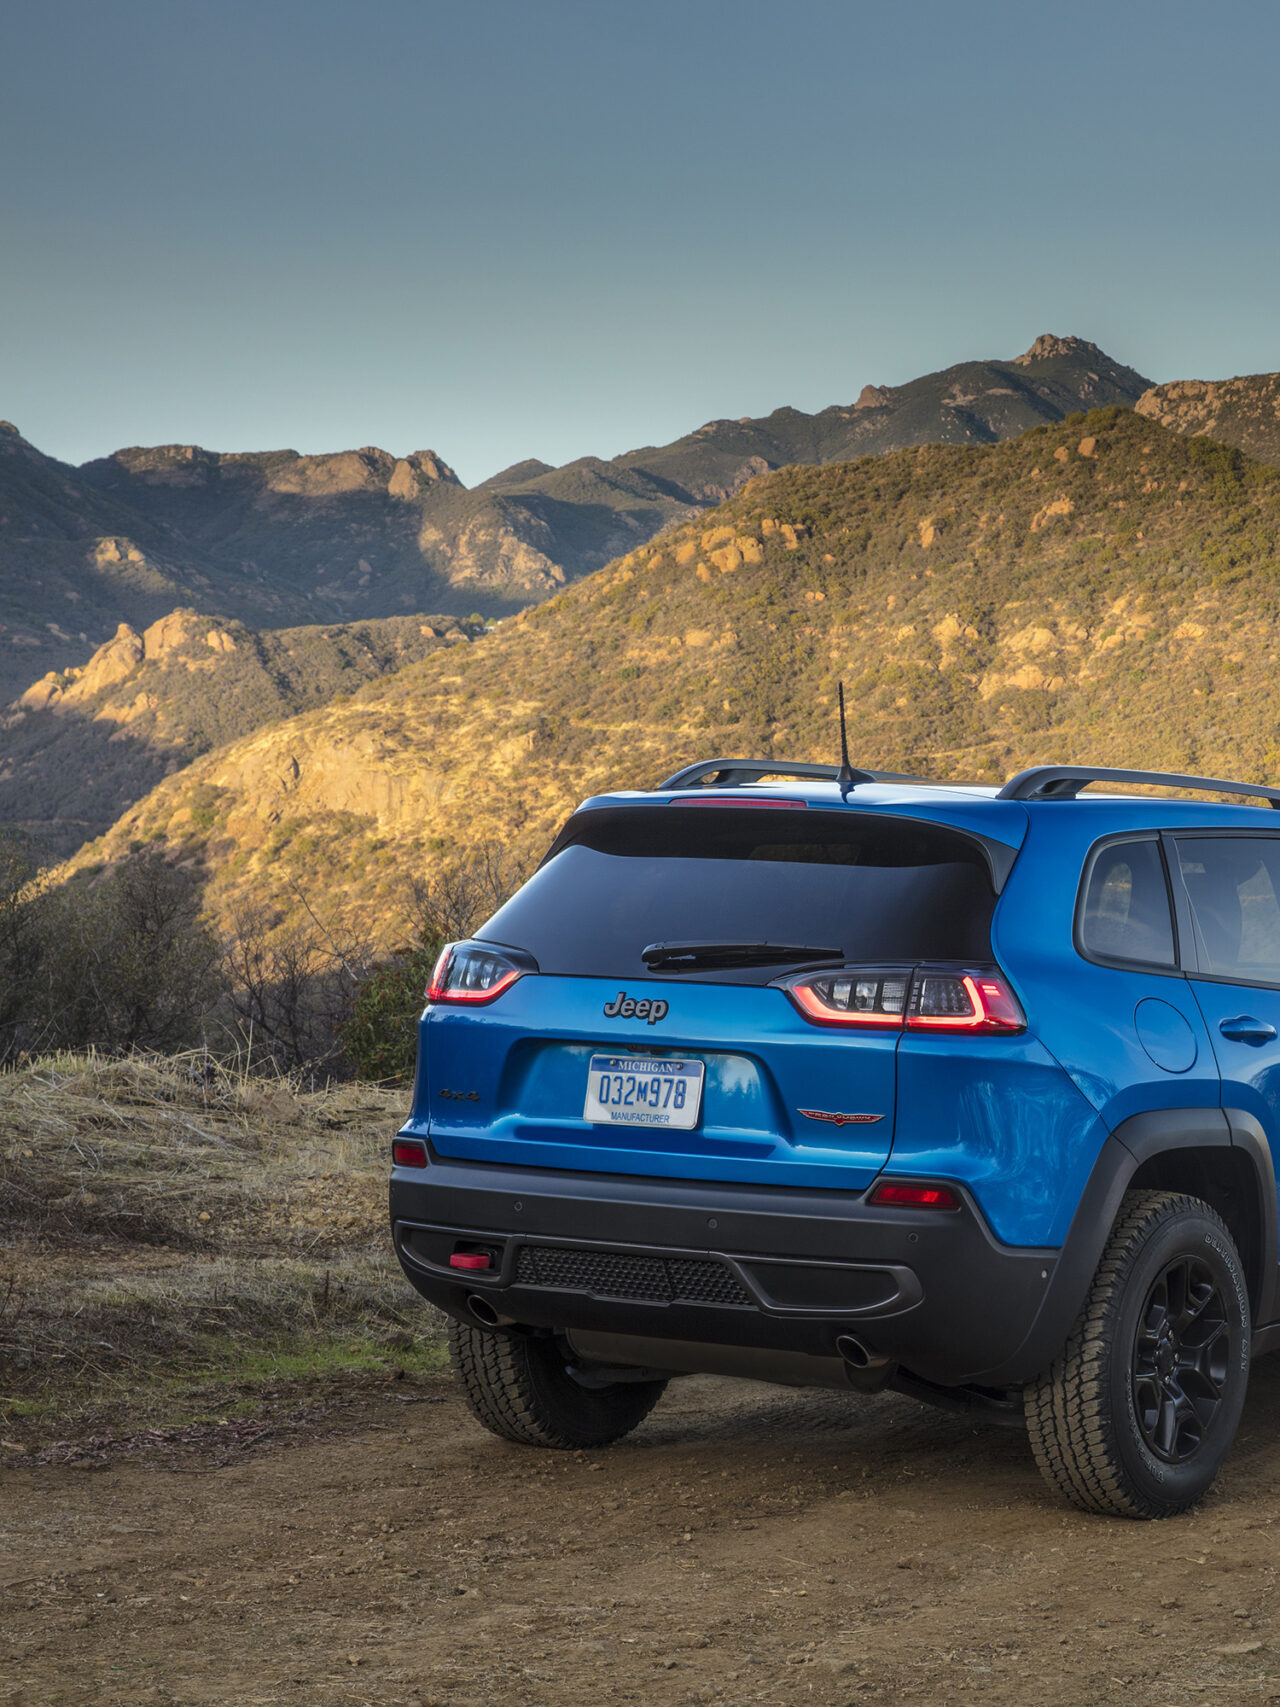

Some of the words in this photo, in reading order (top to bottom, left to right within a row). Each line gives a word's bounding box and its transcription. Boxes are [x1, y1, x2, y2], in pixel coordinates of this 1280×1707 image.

[604, 992, 669, 1025] Jeep
[618, 1060, 674, 1073] MICHIGAN
[599, 1074, 688, 1109] 032M978
[611, 1111, 670, 1124] MANUFACTURER
[1204, 1232, 1248, 1328] DESTINATION
